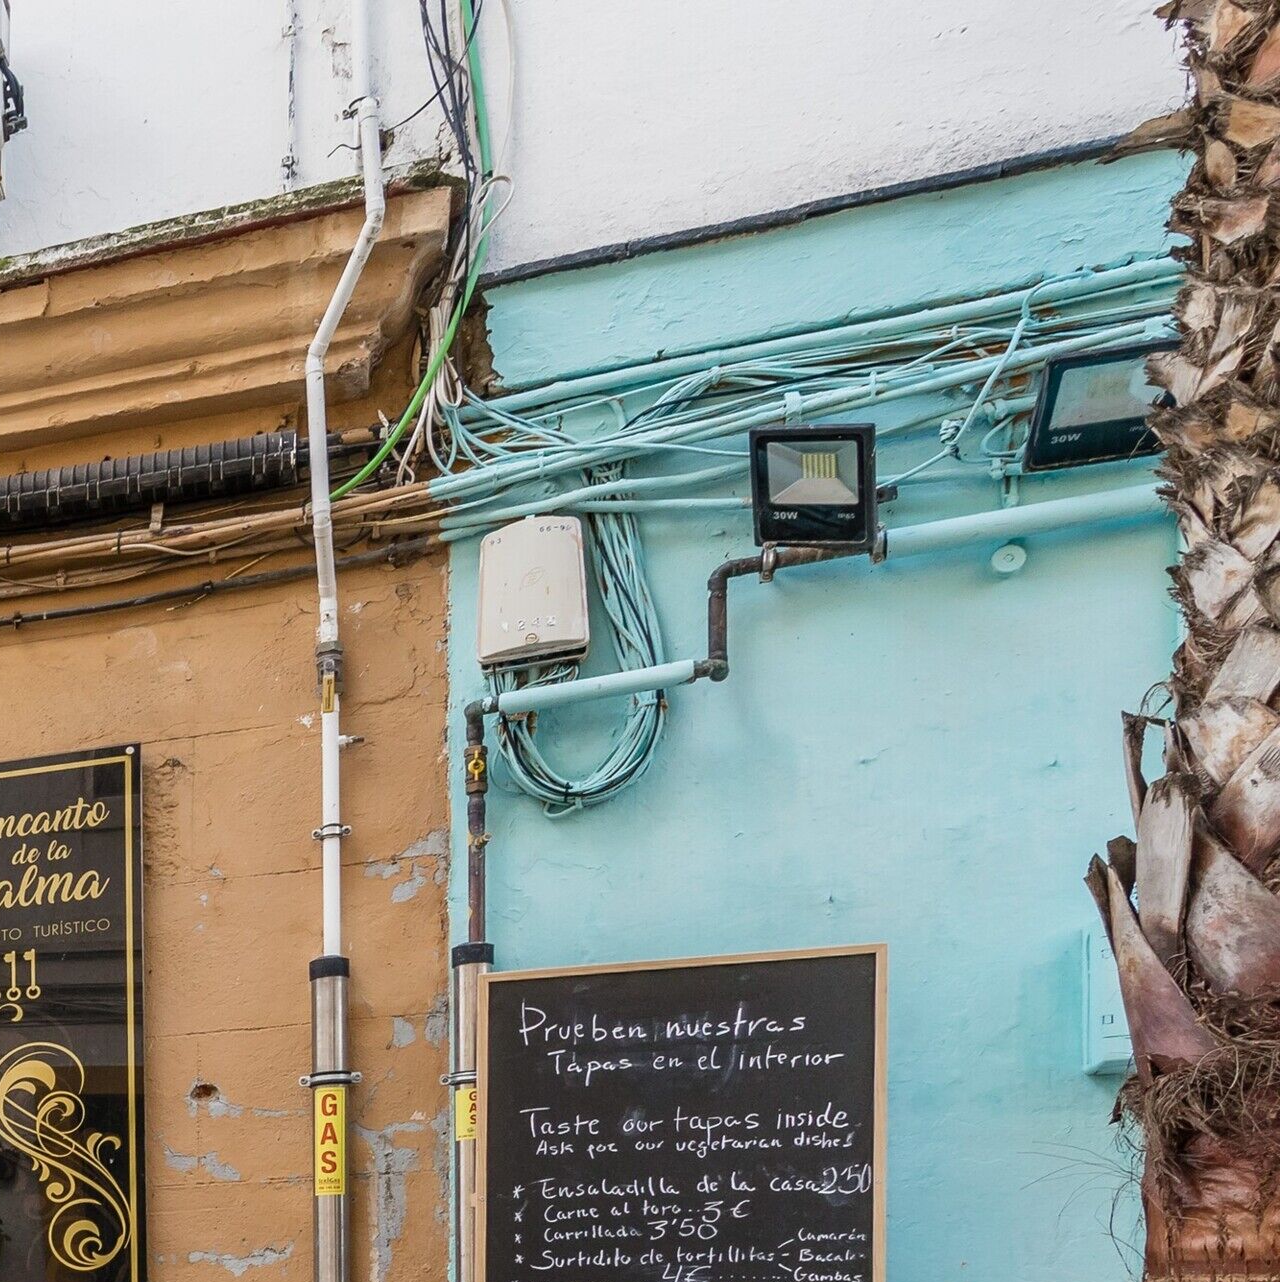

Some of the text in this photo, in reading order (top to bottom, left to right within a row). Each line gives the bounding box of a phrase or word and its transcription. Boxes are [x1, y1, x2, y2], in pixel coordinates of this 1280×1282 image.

[1049, 433, 1082, 445] 30W
[772, 511, 799, 520] 30W
[11, 839, 73, 865] de la
[33, 918, 111, 938] TURÍSTICO
[519, 999, 807, 1046] Prueben nuestras
[547, 1046, 844, 1085] Tapas en el interior
[320, 1093, 338, 1174] GAS
[519, 1102, 849, 1141] Taste our tapas inside
[535, 1135, 574, 1155] Ask
[635, 1140, 664, 1151] our
[676, 1135, 782, 1158] vegetarian
[794, 1130, 853, 1147] dishes
[536, 1177, 680, 1198] Ensaladilla
[697, 1175, 718, 1193] de
[731, 1172, 756, 1191] la
[770, 1177, 819, 1191] casa
[544, 1205, 599, 1222] Carne
[610, 1202, 630, 1216] al
[544, 1225, 642, 1243] Carrillada
[530, 1249, 631, 1270] Surtidito
[640, 1248, 663, 1265] de
[676, 1245, 775, 1264] tortillitas
